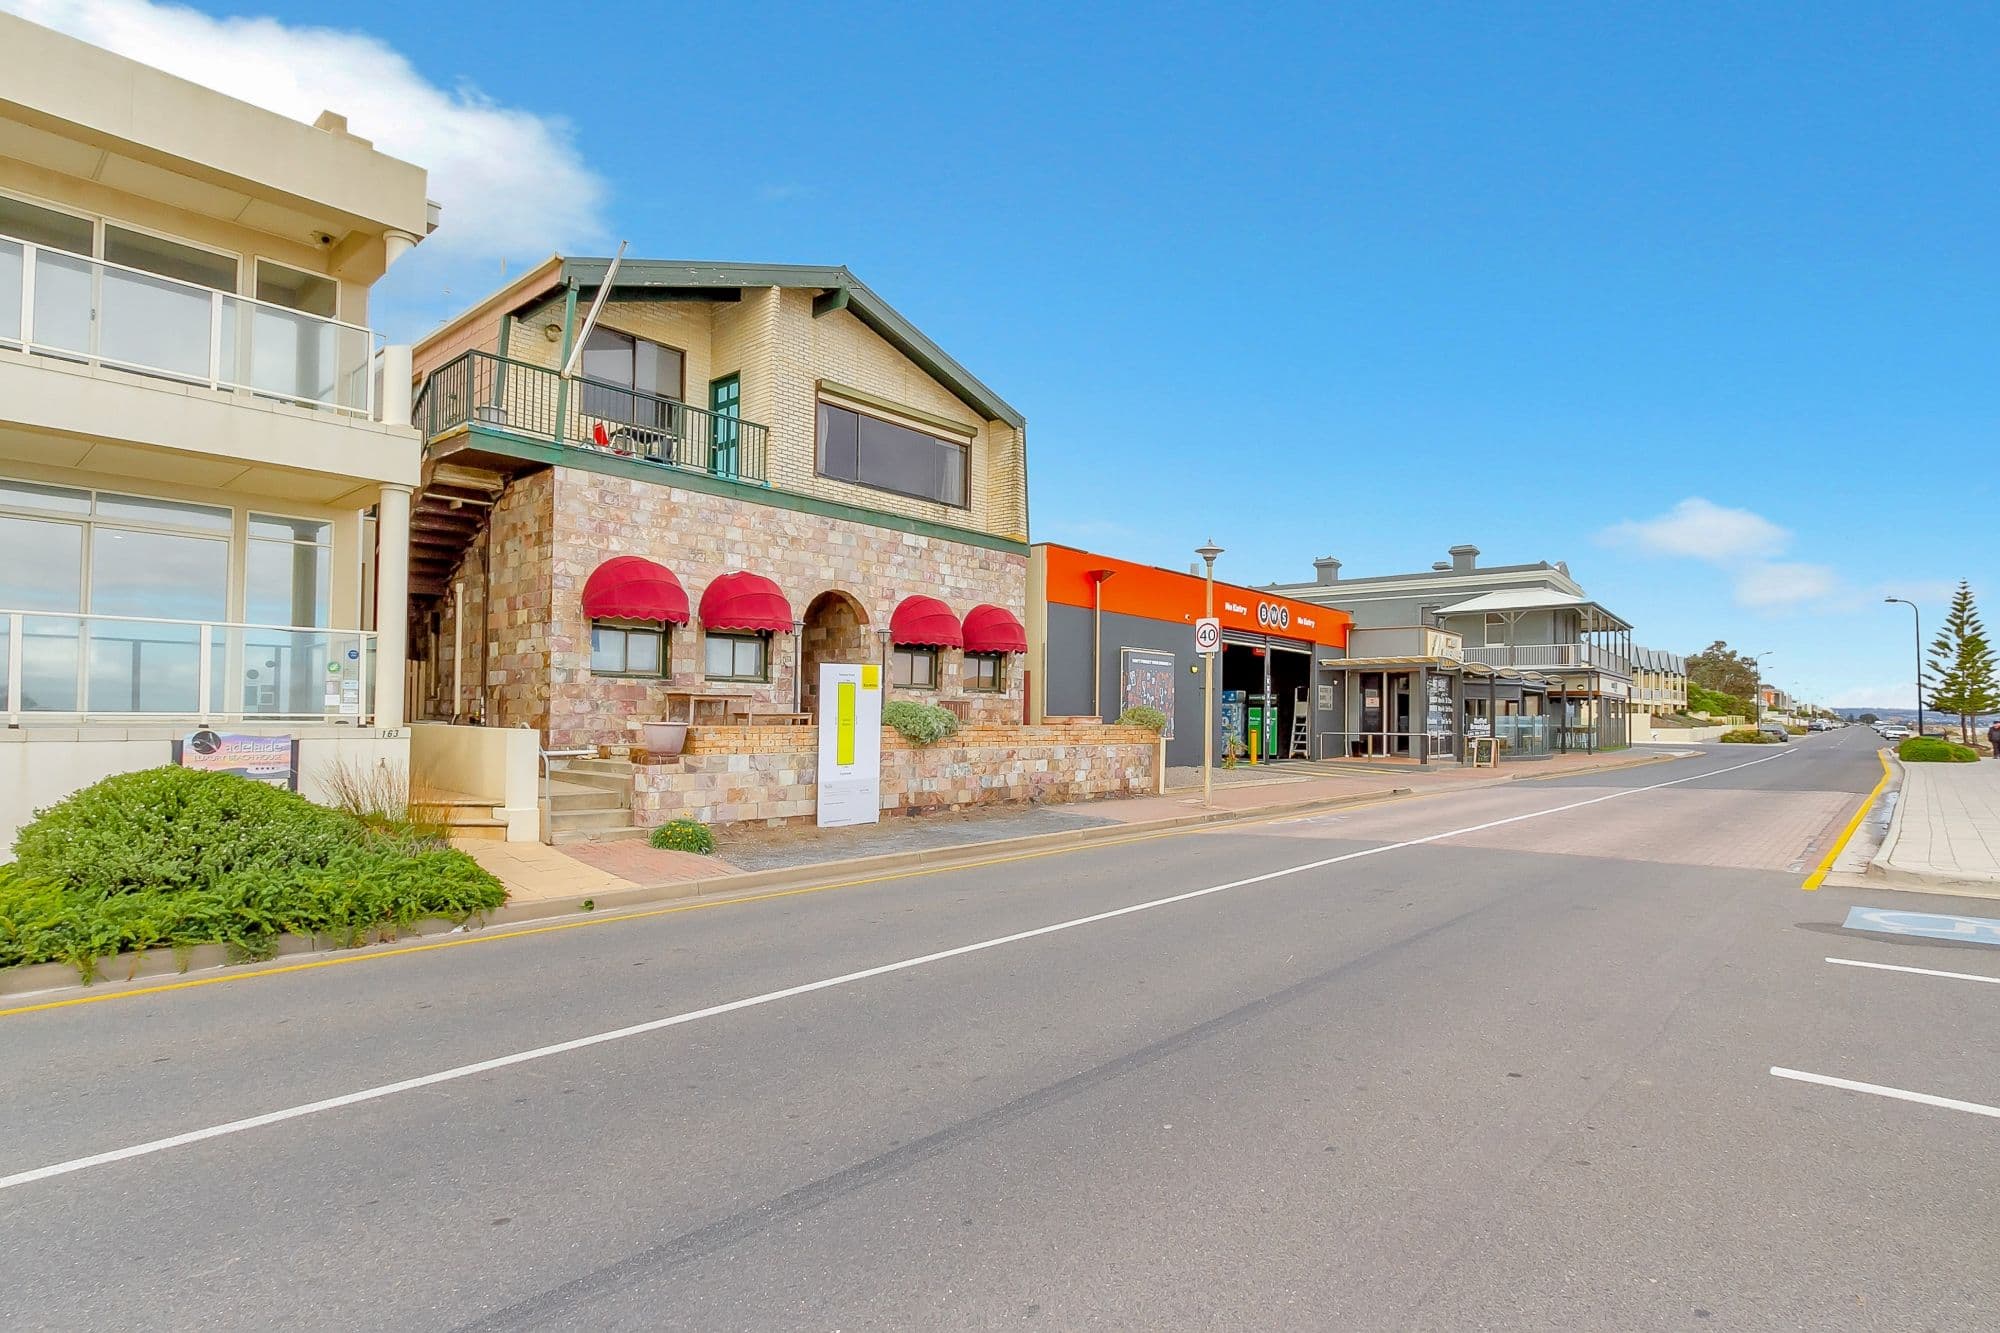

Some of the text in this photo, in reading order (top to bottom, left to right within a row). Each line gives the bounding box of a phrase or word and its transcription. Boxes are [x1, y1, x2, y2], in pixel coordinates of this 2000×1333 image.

[1261, 605, 1288, 624] BWS
[1200, 629, 1215, 641] 40
[381, 730, 399, 738] 163
[225, 741, 282, 753] adelaide
